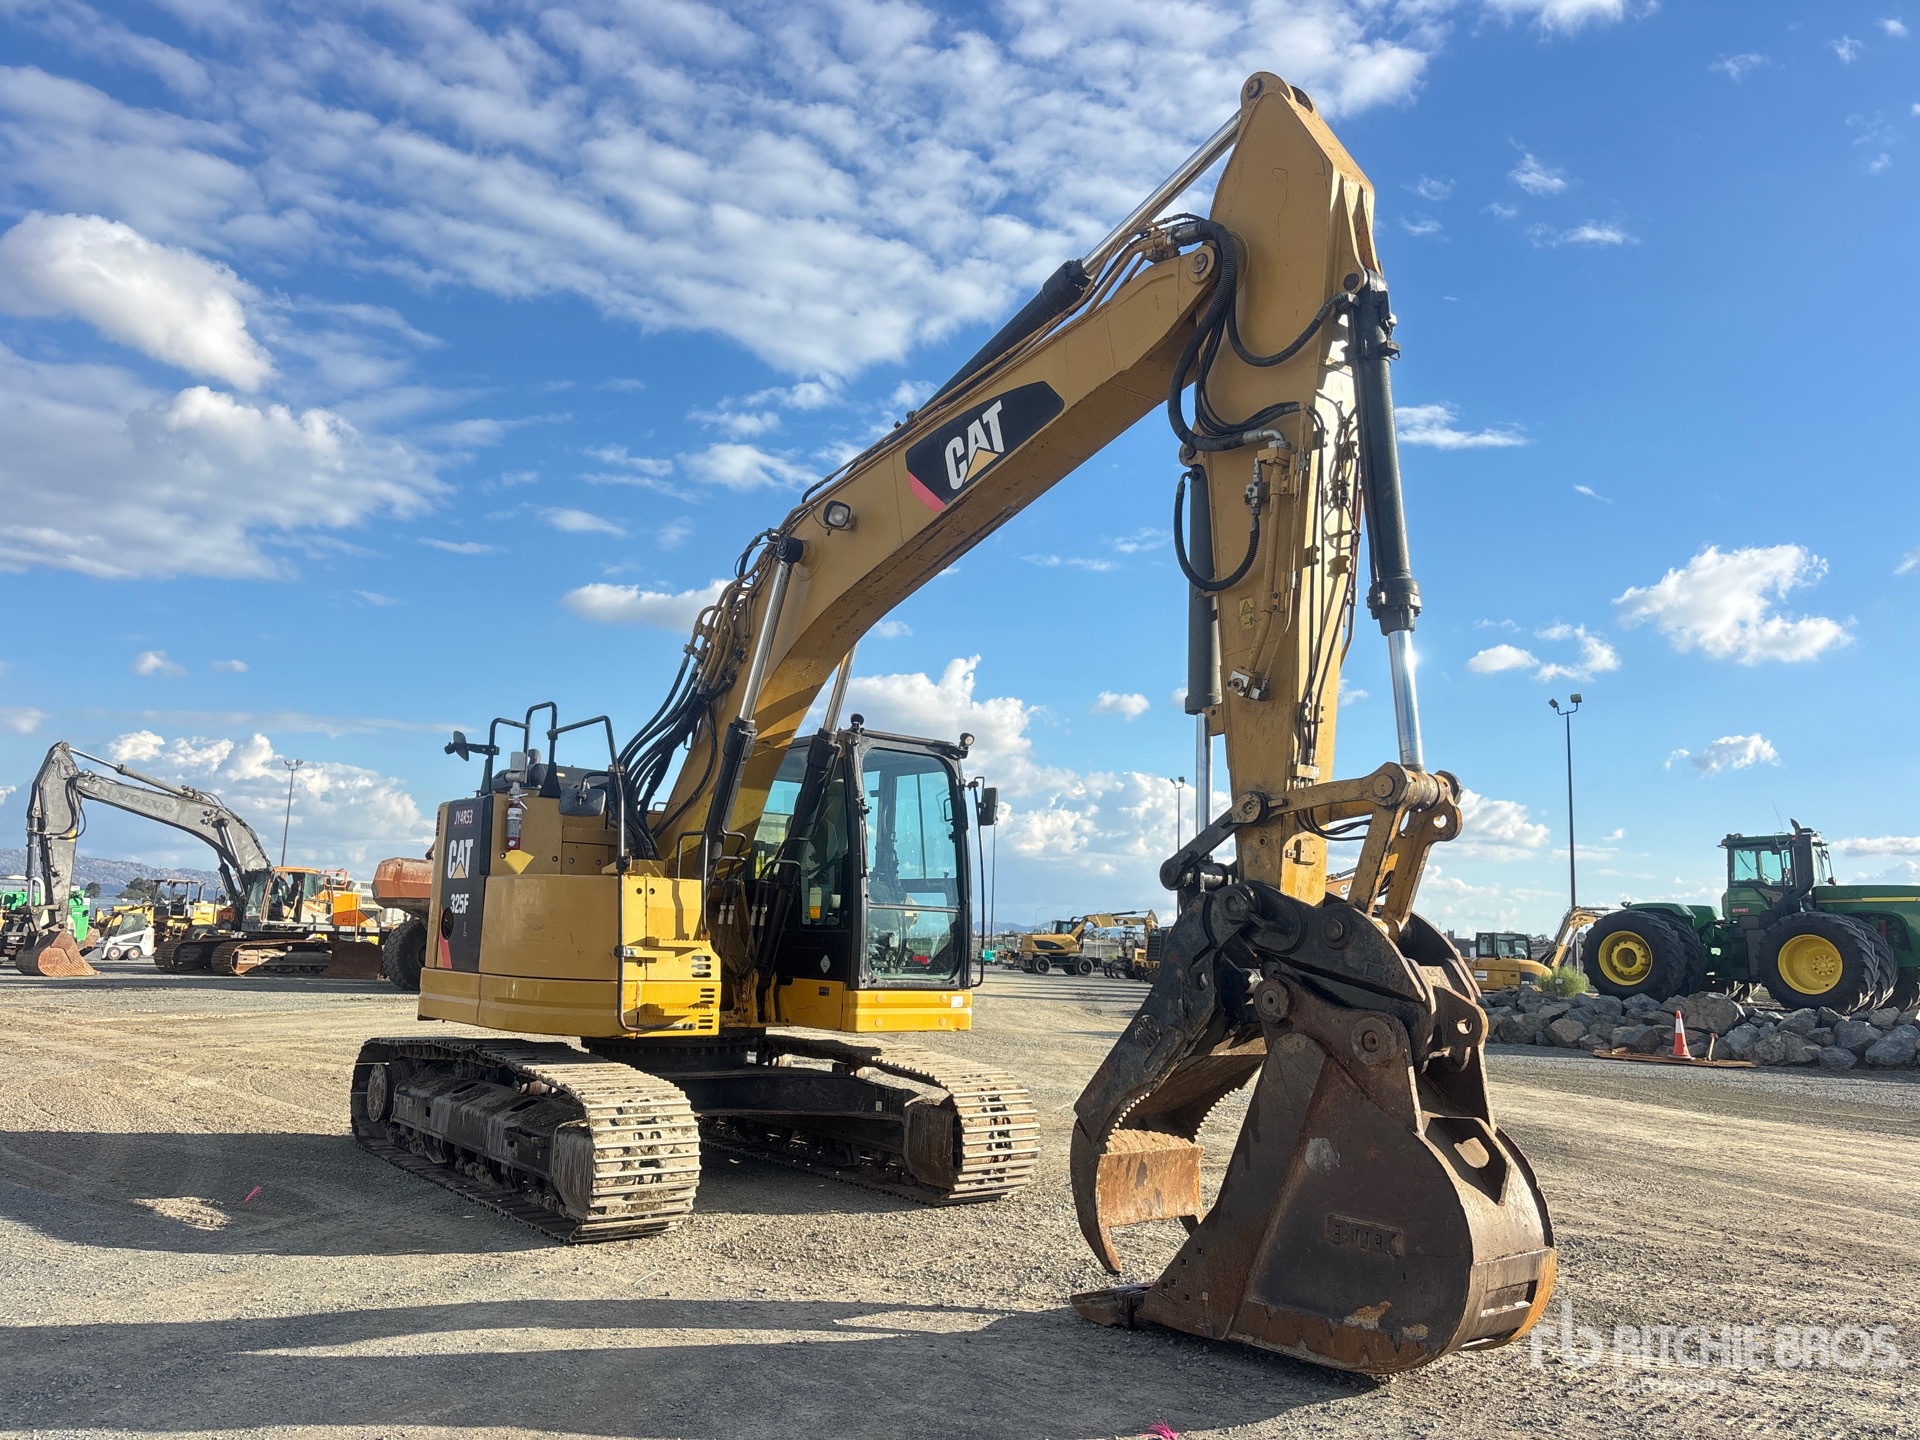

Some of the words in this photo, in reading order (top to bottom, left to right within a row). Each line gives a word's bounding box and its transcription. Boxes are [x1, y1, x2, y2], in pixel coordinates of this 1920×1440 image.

[944, 400, 1004, 490] CAT
[448, 839, 472, 878] CAT
[451, 894, 469, 913] 325F
